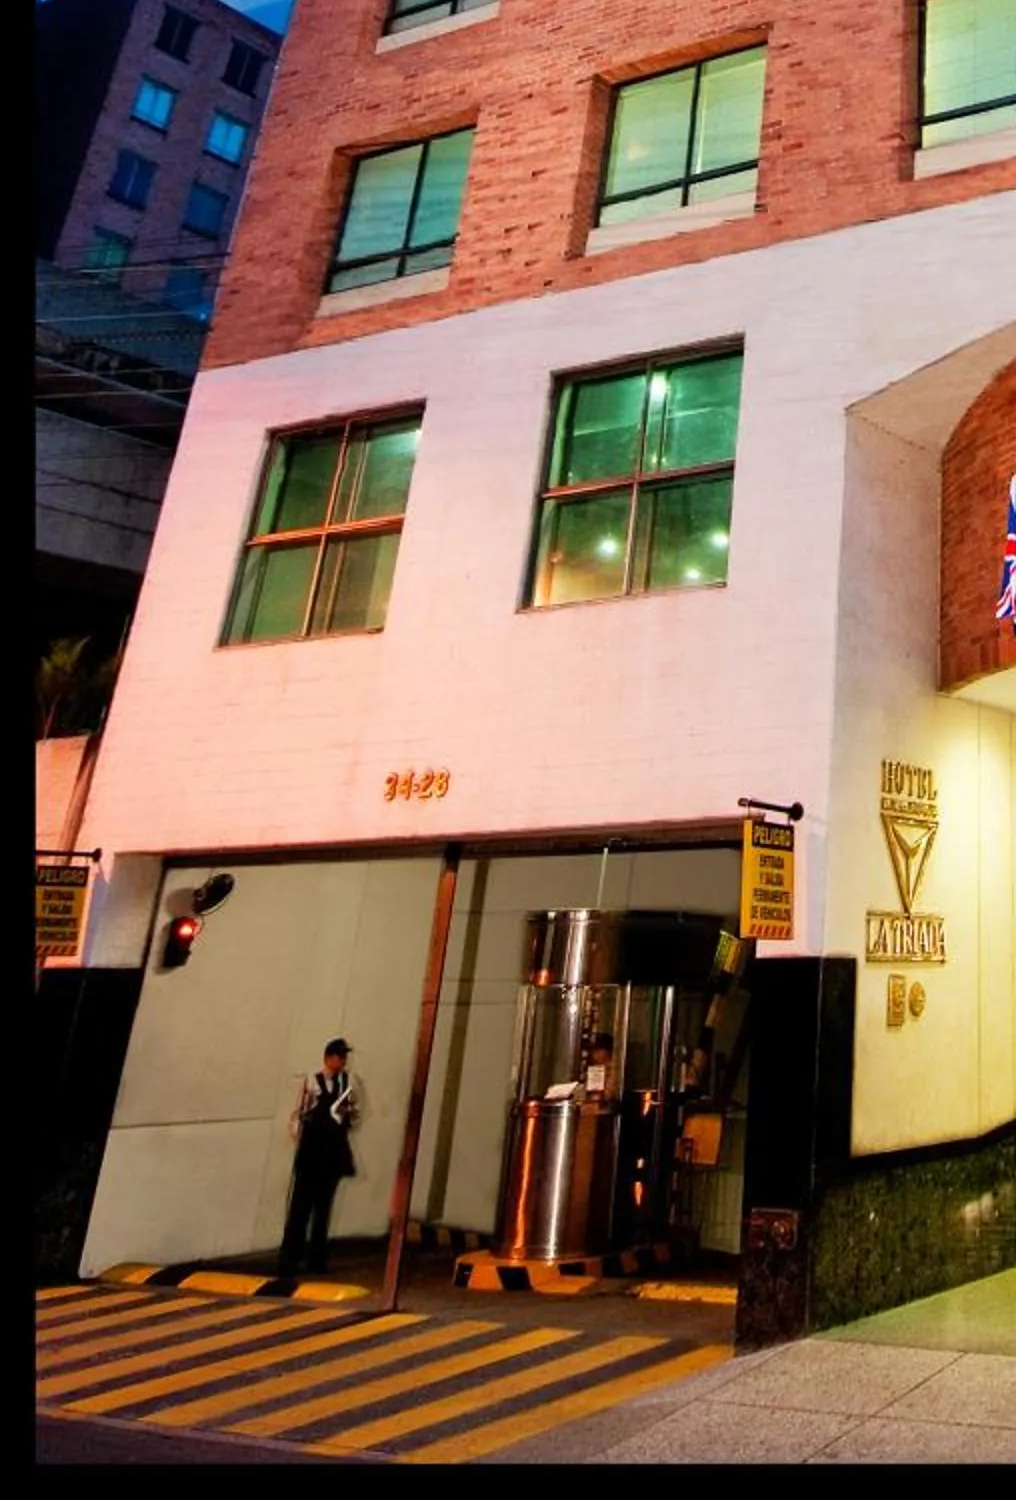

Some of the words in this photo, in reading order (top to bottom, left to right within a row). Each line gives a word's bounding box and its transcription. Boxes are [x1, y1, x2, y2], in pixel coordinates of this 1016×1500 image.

[880, 758, 938, 801] HOTEL
[754, 824, 791, 848] PELIGRO
[866, 917, 890, 955] LA
[890, 916, 947, 956] TRIADA
